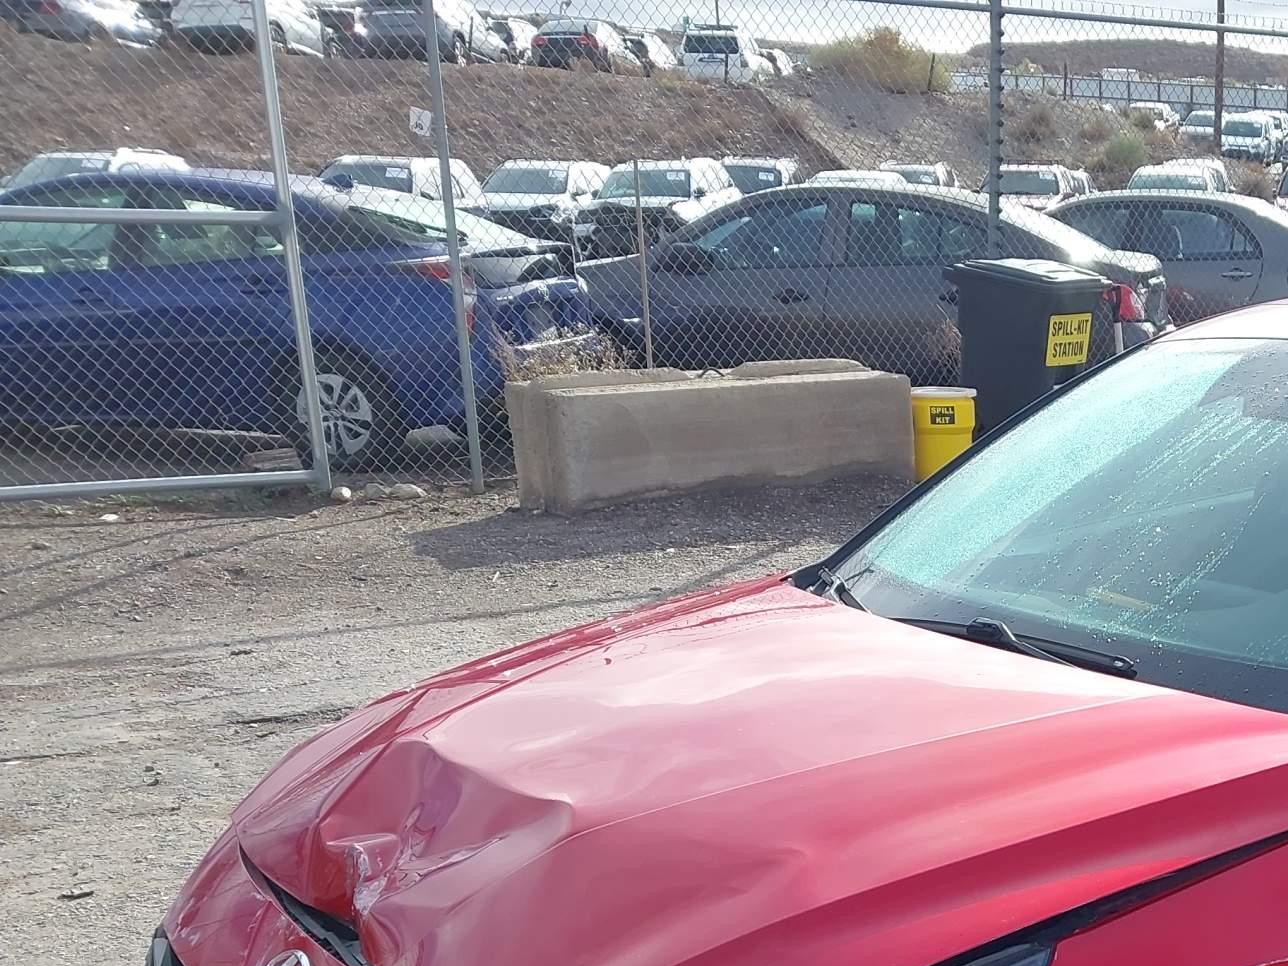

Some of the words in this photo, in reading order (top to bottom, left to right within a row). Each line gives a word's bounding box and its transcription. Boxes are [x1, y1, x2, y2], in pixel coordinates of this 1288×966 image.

[1051, 319, 1090, 337] SPILL-KIT
[1052, 340, 1085, 358] STATION
[930, 407, 954, 415] SPILL
[935, 416, 951, 424] KIT
